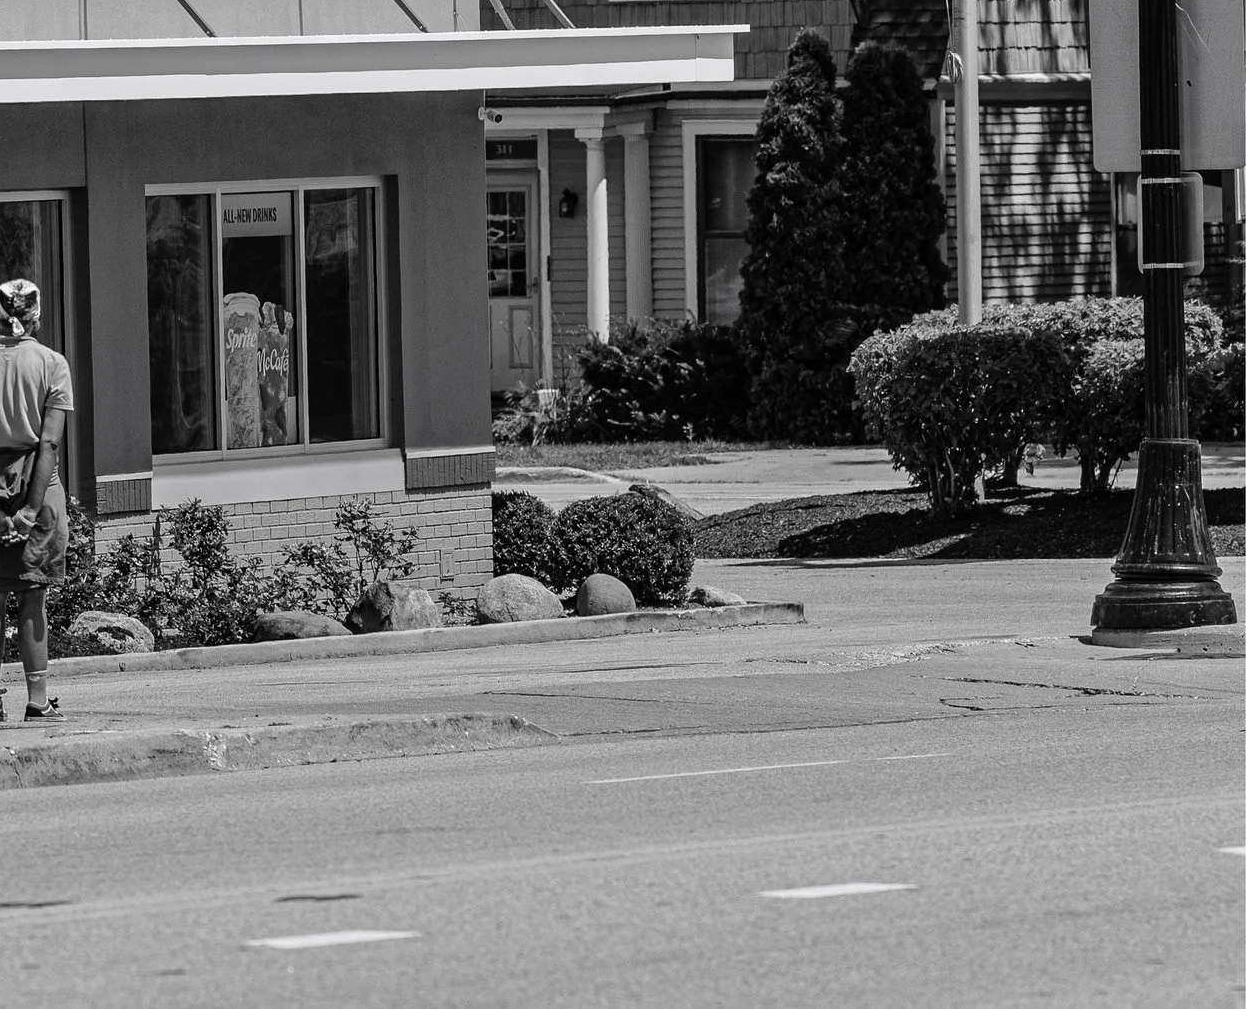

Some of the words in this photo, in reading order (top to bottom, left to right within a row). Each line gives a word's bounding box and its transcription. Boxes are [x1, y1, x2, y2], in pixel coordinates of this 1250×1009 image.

[223, 208, 251, 224] ALL-NEW
[252, 206, 278, 223] DRINKS
[225, 326, 257, 353] Sprite
[257, 348, 289, 377] McCafé
